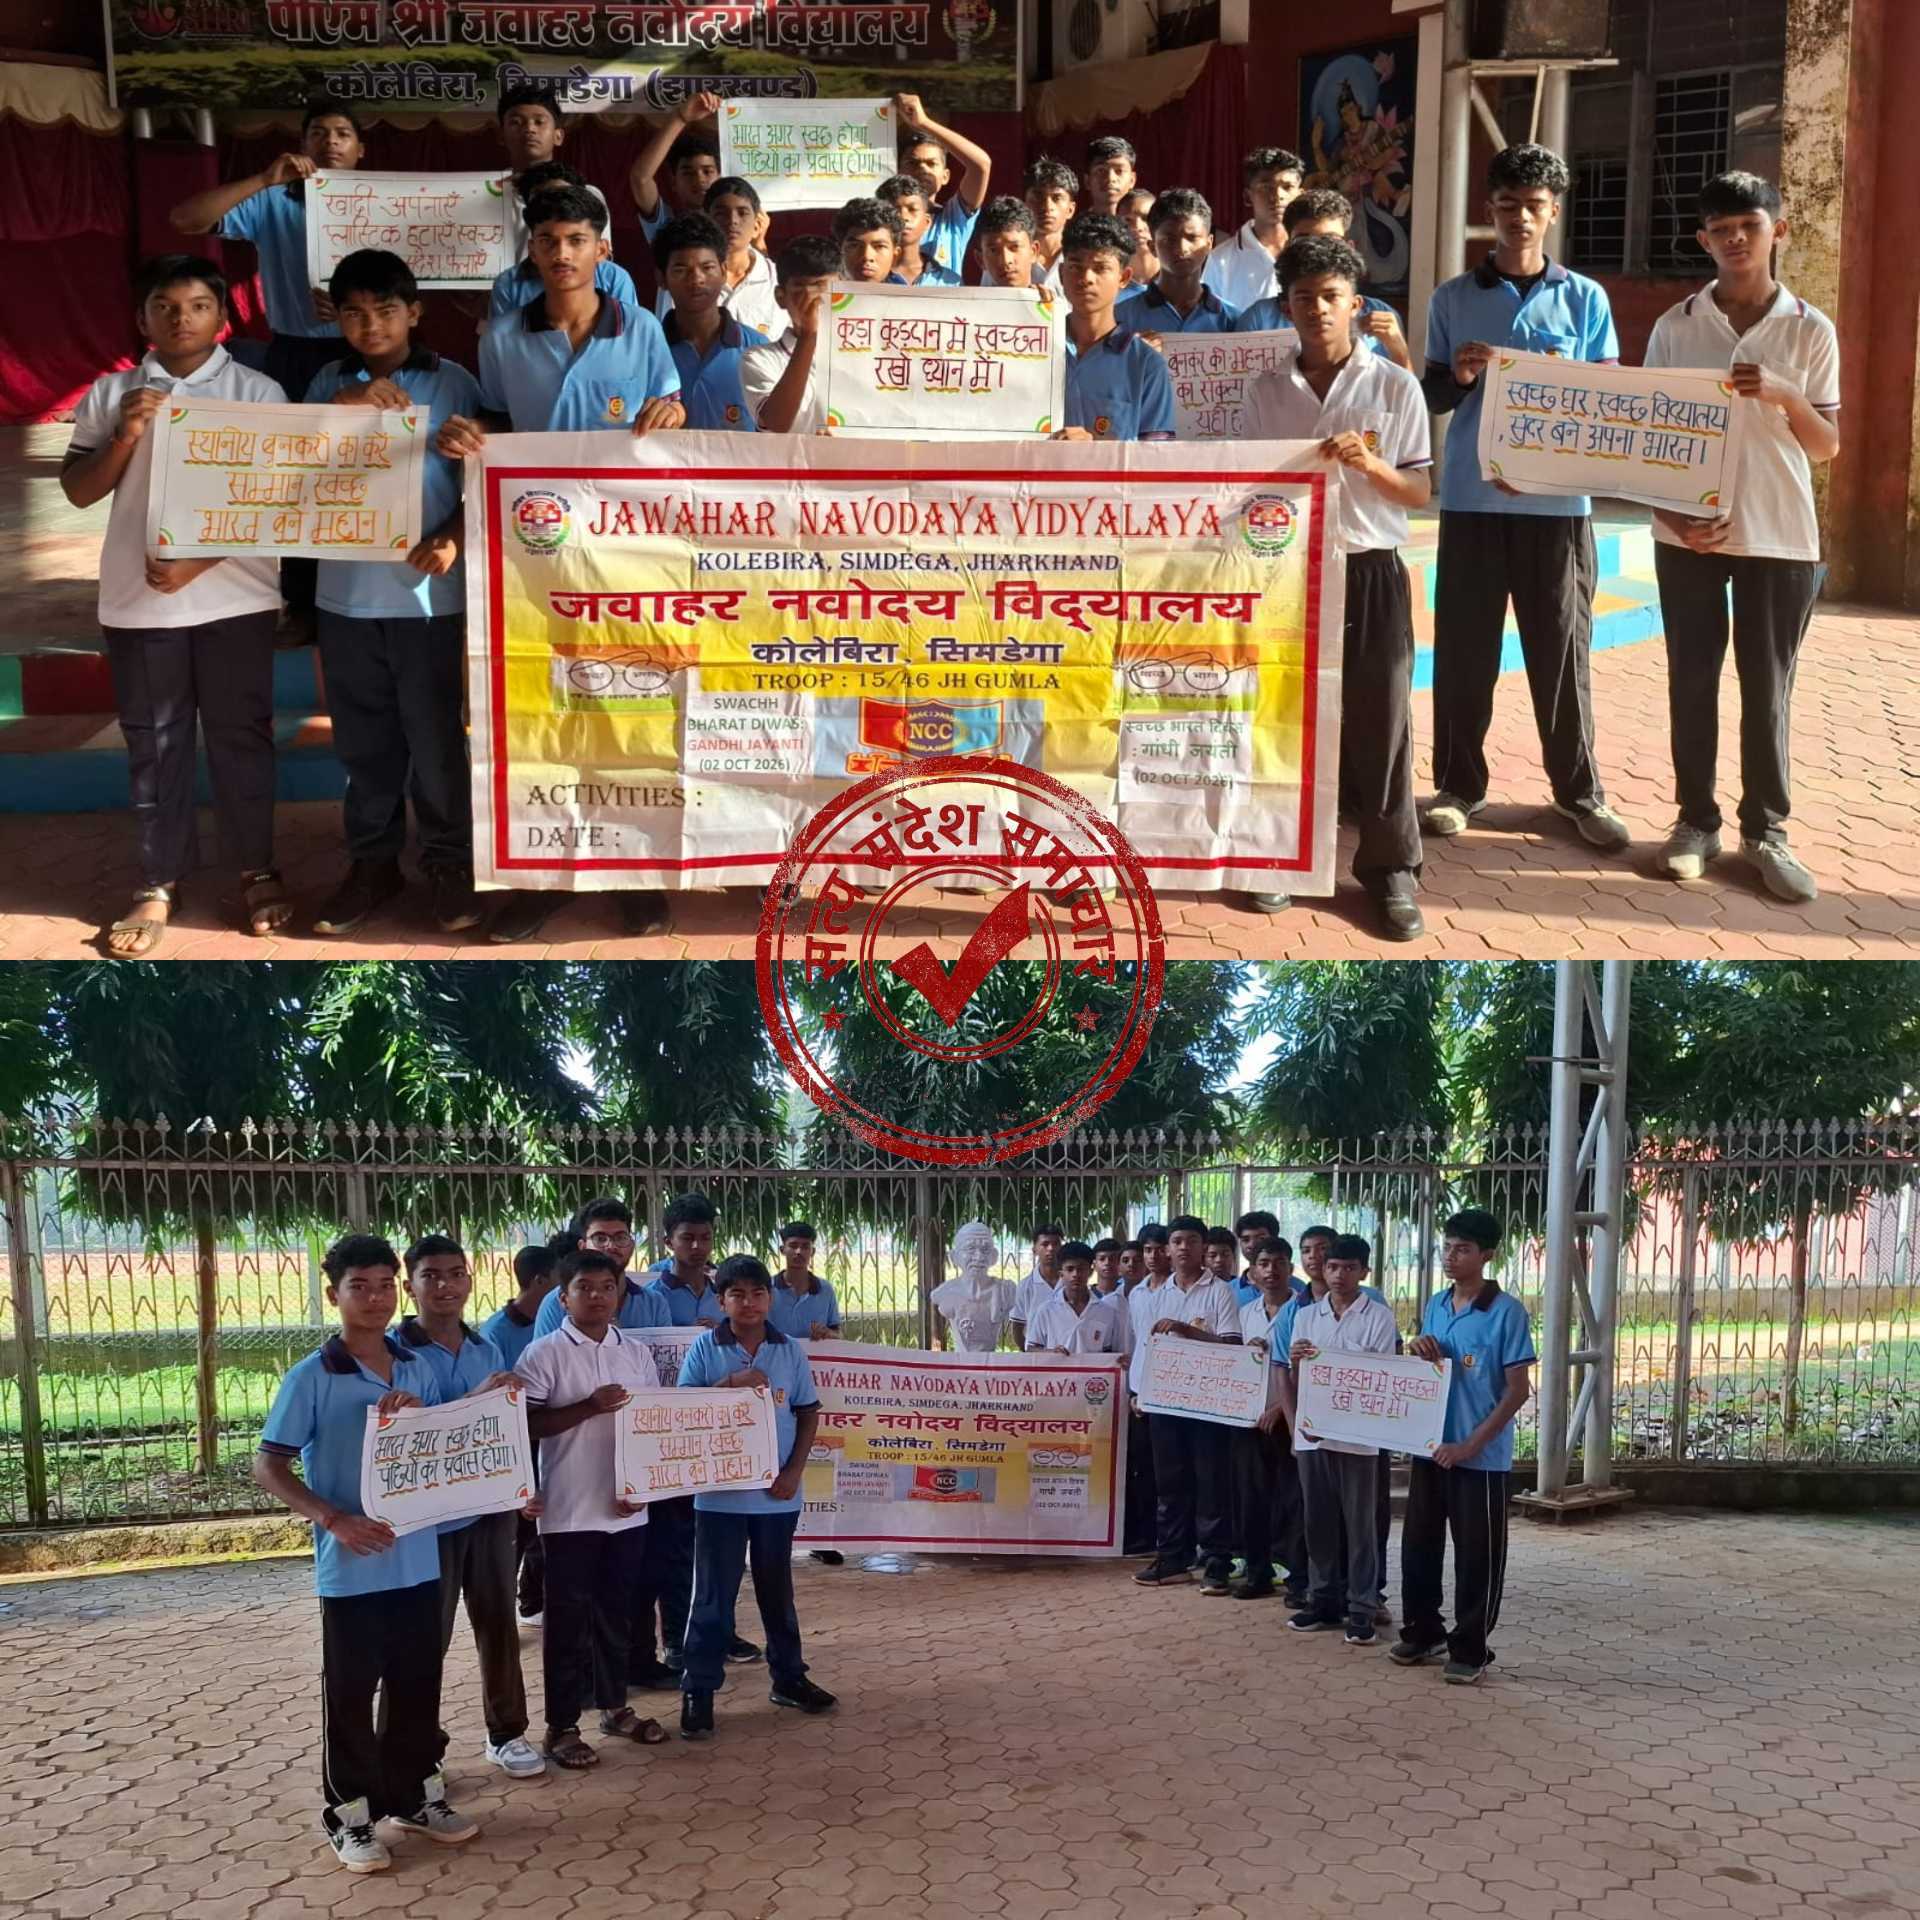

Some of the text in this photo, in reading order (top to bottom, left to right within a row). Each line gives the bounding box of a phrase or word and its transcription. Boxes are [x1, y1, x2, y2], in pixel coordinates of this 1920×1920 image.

[267, 0, 931, 50] पीएम श्री जवाहर नवोदय विद्यालय
[946, 316, 970, 350] में
[920, 358, 967, 388] ध्यान
[1586, 422, 1637, 456] अपना
[588, 494, 778, 537] JAWAHAR
[798, 495, 999, 537] NAVODAYA
[1011, 496, 1223, 537] VIDYALAYA
[697, 551, 1120, 573] KOLEBIRA, SIMDEGA, JHARKHAND
[549, 578, 1263, 633] जवाहर नवोदय विद्यालय
[925, 636, 1066, 664] सिमडेगा
[752, 673, 834, 690] TROOP
[858, 671, 930, 688] 15/46
[937, 673, 966, 689] JH
[974, 673, 1061, 691] GUMLA
[713, 697, 779, 710] SWACHH
[687, 718, 746, 732] BHARAT
[909, 723, 953, 740] NCC
[1169, 720, 1206, 734] भारत
[687, 739, 804, 752] GANDHI JAYANTI
[700, 758, 721, 774] (02
[724, 759, 753, 772] OCT
[1161, 772, 1193, 785] OCT
[527, 782, 686, 808] ACTIVITIES
[528, 826, 604, 849] DATE
[890, 1374, 980, 1396] NAVODAYA
[985, 1377, 1078, 1397] VIDYALAYA
[875, 1411, 964, 1432] नवोदय
